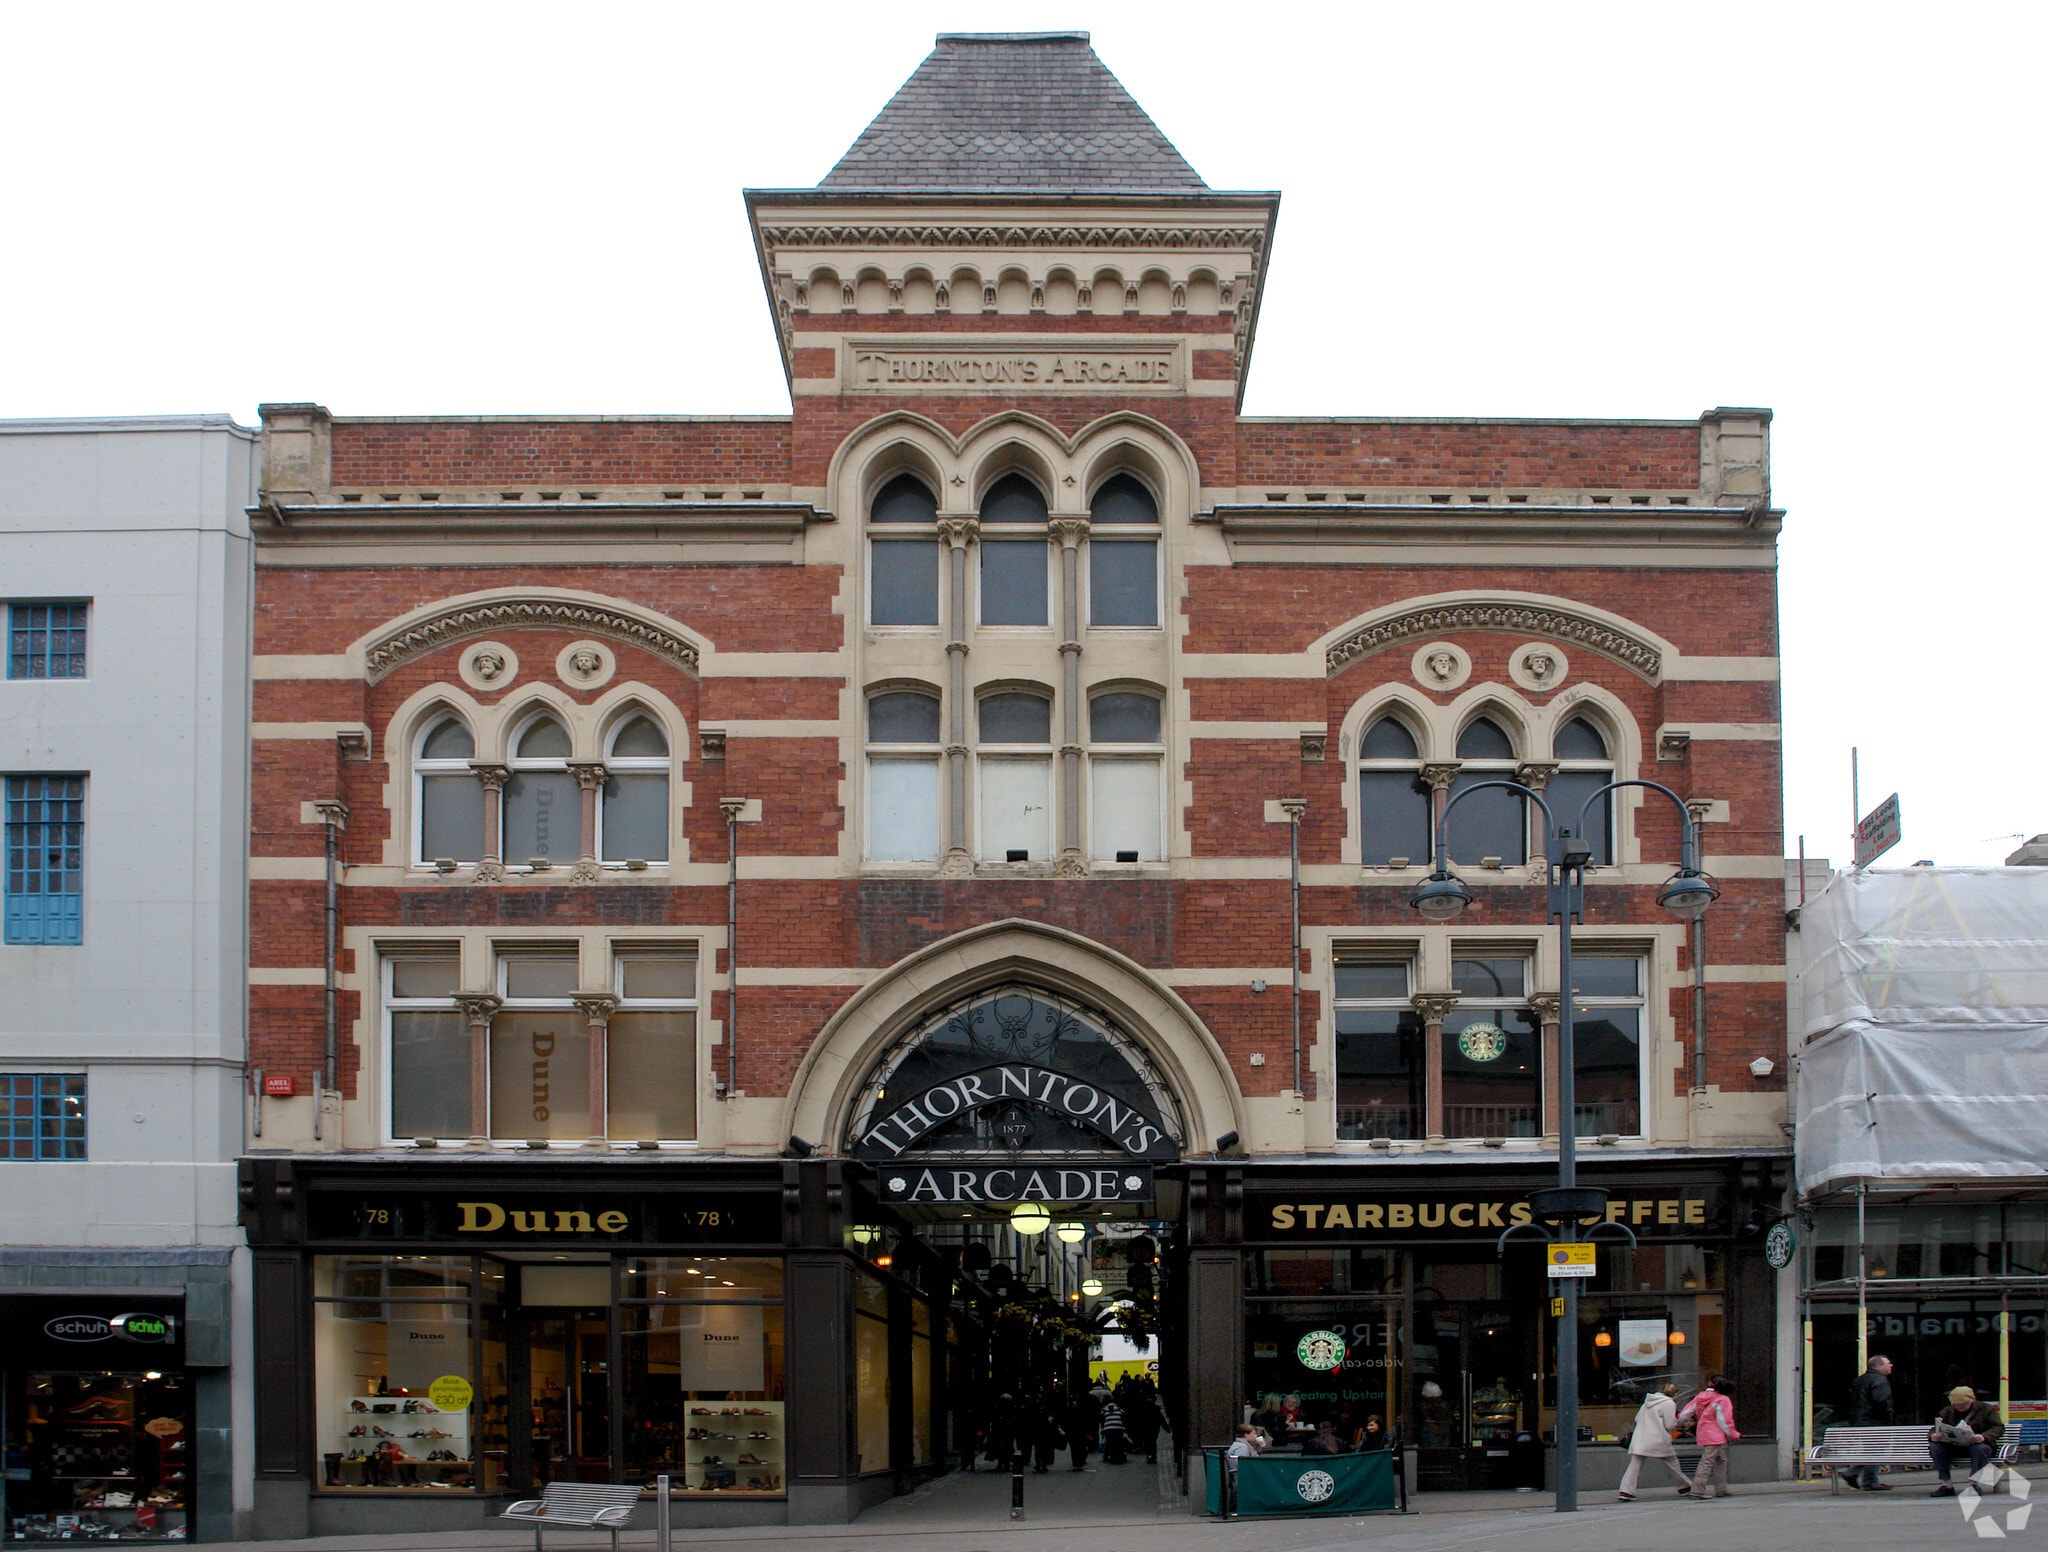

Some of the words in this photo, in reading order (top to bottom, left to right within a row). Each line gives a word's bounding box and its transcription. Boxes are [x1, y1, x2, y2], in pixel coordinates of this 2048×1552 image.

[858, 353, 1040, 382] THORNTON'S
[1045, 356, 1170, 383] ARCADE
[537, 788, 553, 855] Dune
[1860, 817, 1874, 833] East
[1876, 799, 1896, 820] Leeds
[1860, 812, 1896, 844] Scaffolding
[1873, 830, 1885, 844] Ltd
[1462, 1023, 1504, 1042] STARBUCKS
[1466, 1049, 1500, 1060] COFFEE
[533, 1032, 555, 1122] Dune
[862, 1067, 1164, 1157] THORNTON'S
[1009, 1111, 1018, 1121] T
[1002, 1124, 1027, 1134] 1877
[1010, 1137, 1019, 1146] A
[907, 1168, 1121, 1202] ARCADE
[367, 1209, 389, 1224] 78
[457, 1202, 629, 1233] Dune
[697, 1211, 720, 1226] 78
[1271, 1202, 1533, 1229] STARBUCKS
[1543, 1200, 1706, 1226] FFEE
[54, 1319, 107, 1334] schuh
[127, 1318, 166, 1335] schuh
[409, 1332, 445, 1340] Dune
[1299, 1332, 1344, 1351] STARBUCKS
[1304, 1357, 1340, 1369] COFFEE
[436, 1395, 455, 1404] £30
[457, 1395, 469, 1404] off
[1293, 1389, 1337, 1402] Seating
[1342, 1389, 1391, 1402] Upstairs
